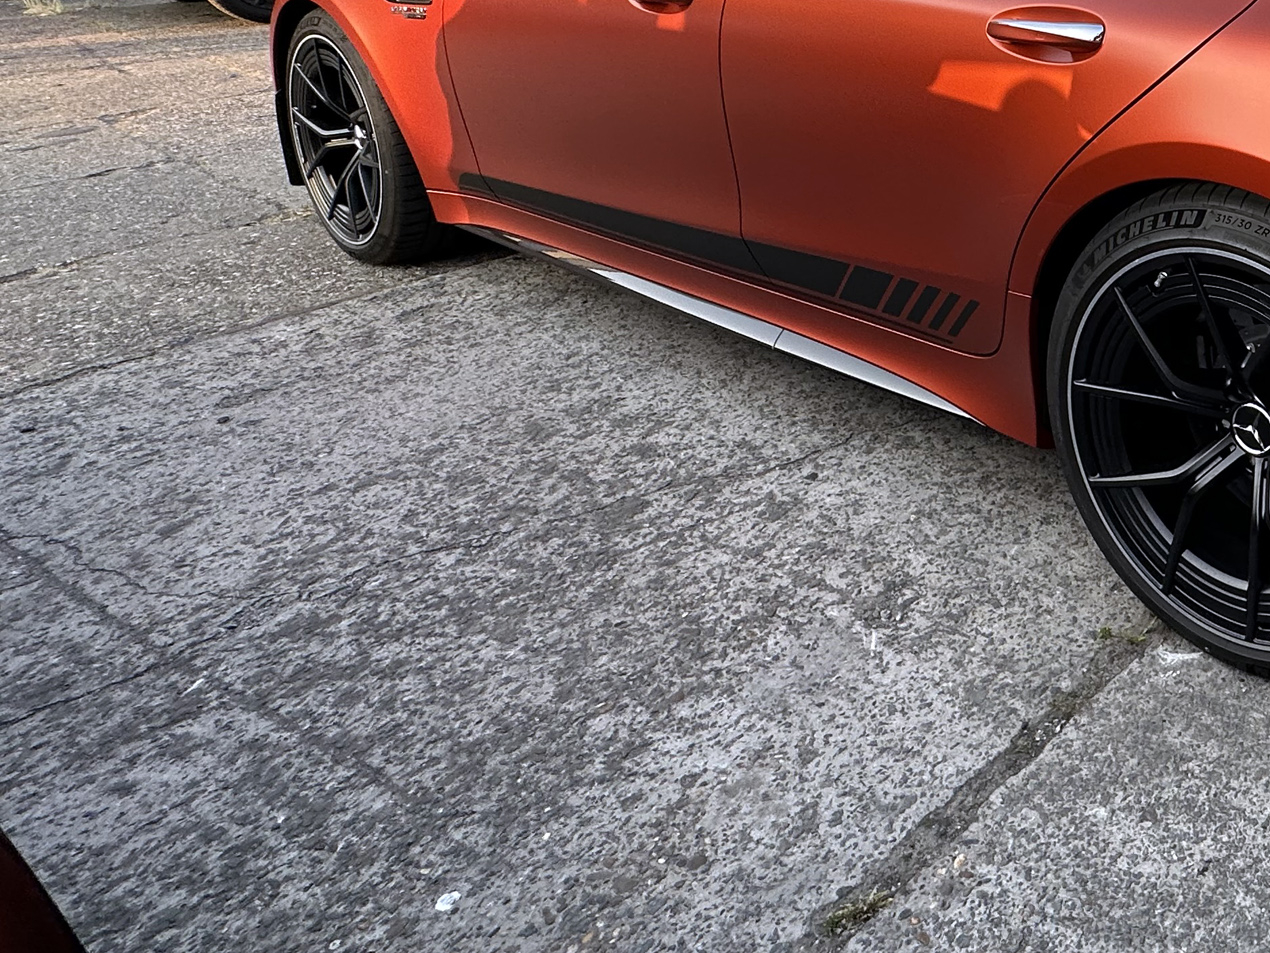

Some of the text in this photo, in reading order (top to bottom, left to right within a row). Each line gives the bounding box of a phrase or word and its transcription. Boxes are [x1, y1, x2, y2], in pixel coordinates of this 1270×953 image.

[1093, 210, 1198, 264] MICHELIN
[1215, 213, 1252, 230] 315/30
[1254, 225, 1270, 237] ZR
